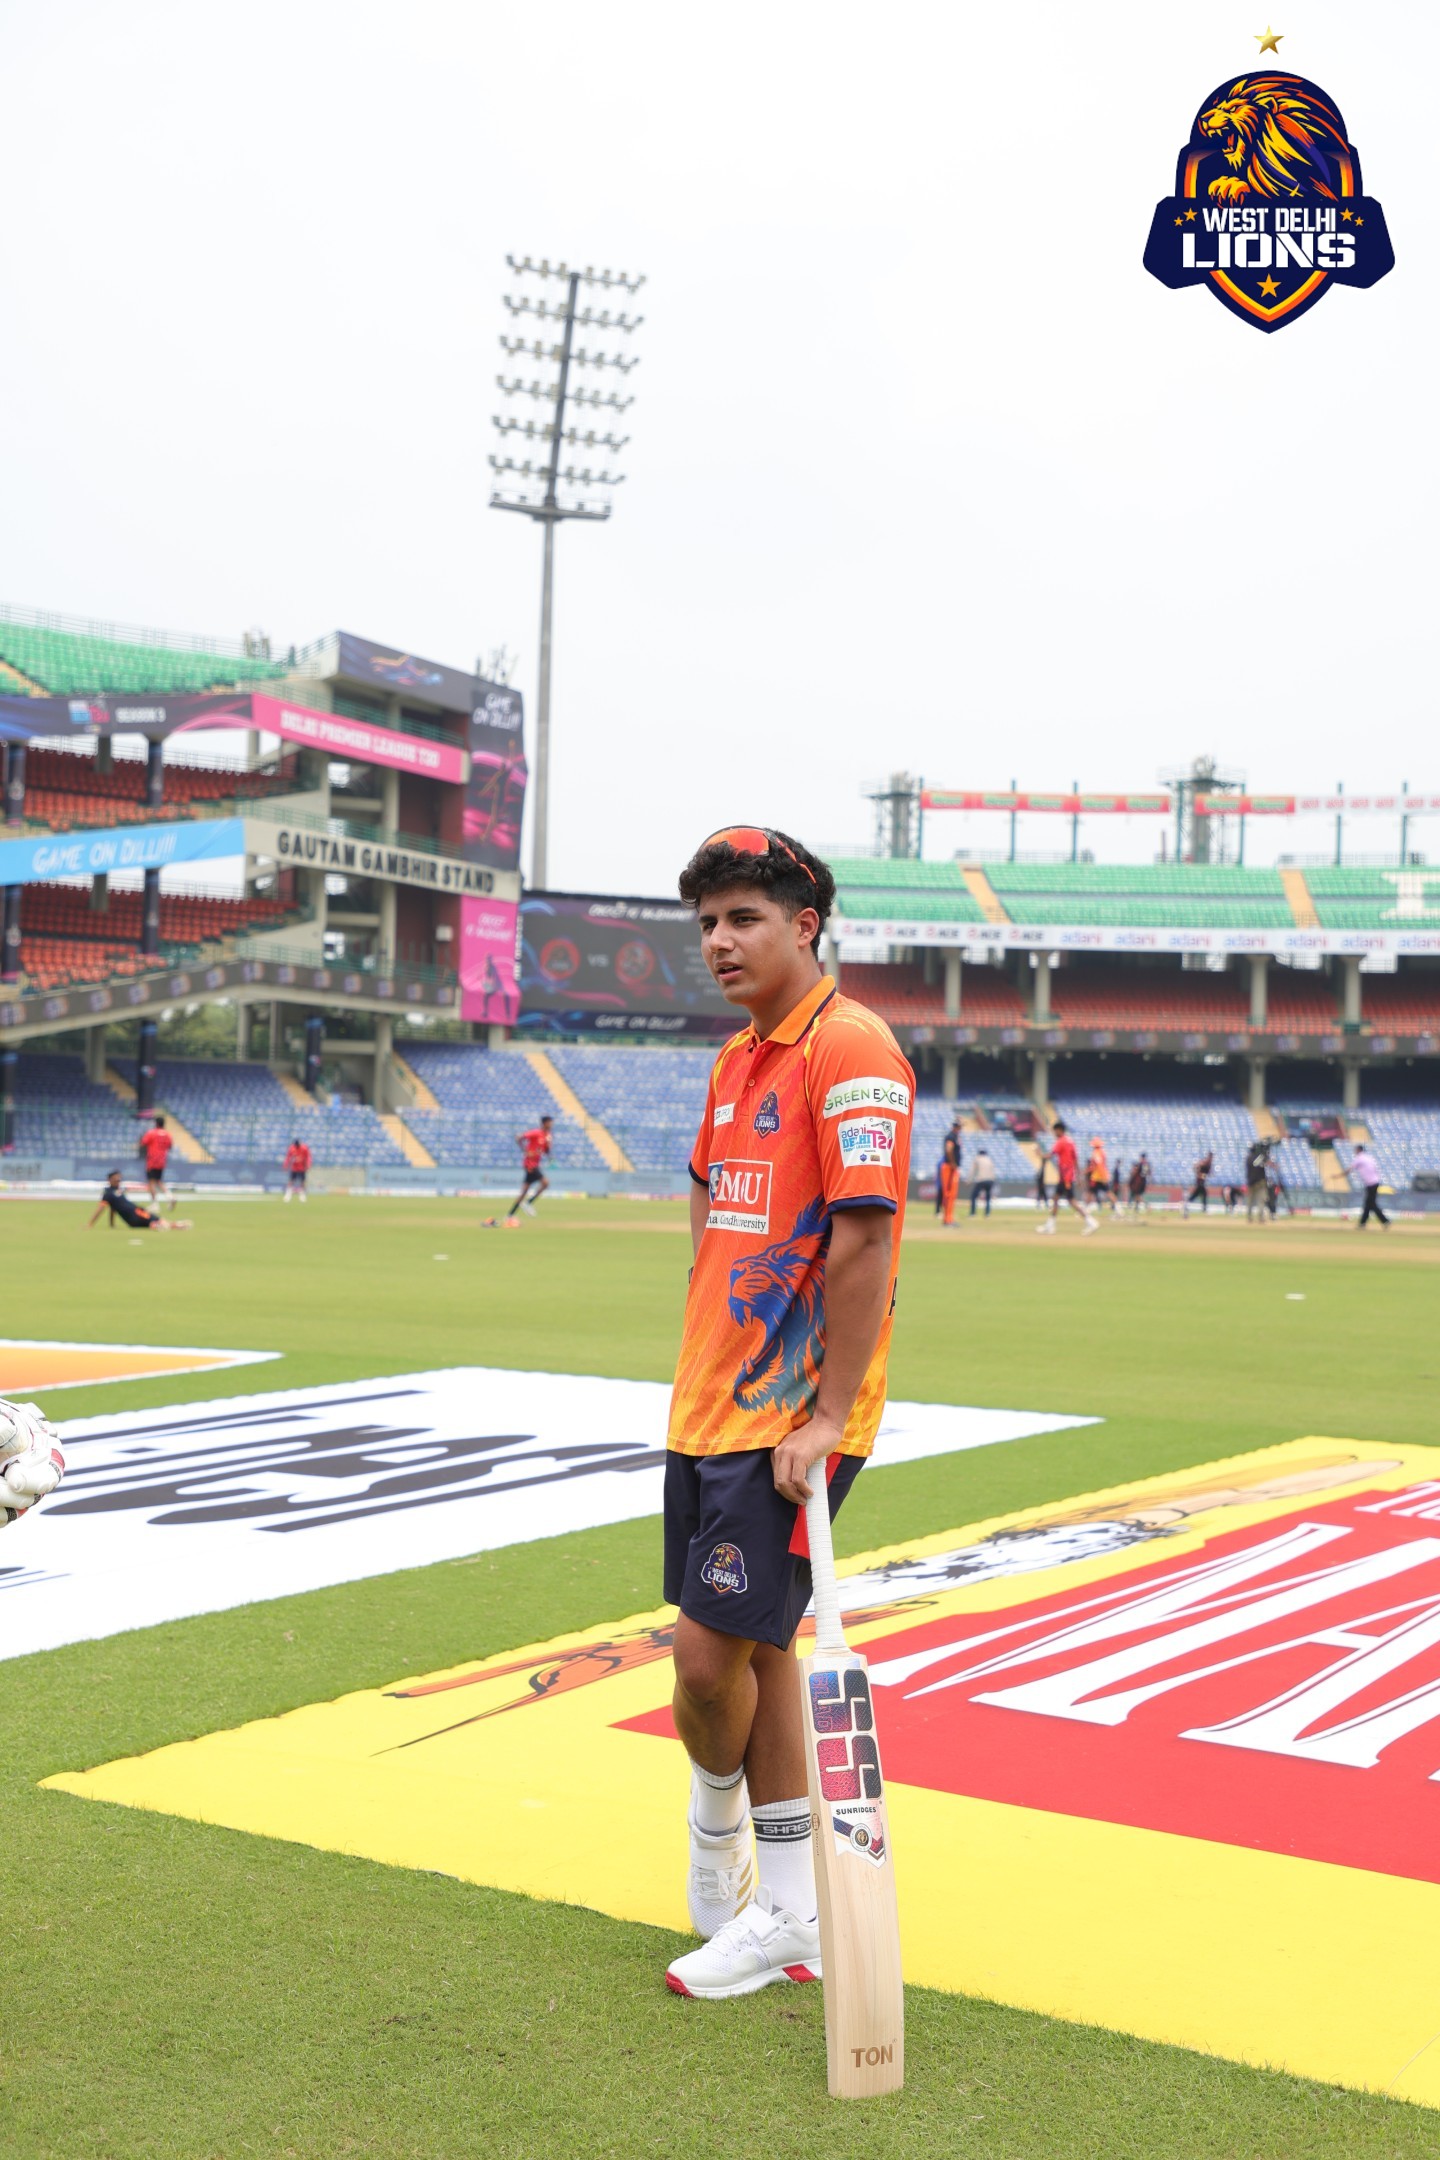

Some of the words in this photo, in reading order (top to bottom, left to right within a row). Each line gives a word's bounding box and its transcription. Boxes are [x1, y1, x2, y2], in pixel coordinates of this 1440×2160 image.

[319, 720, 371, 751] PREMIER
[372, 734, 417, 763] LEAGUE
[32, 843, 84, 874] GAME
[89, 840, 114, 866] ON
[278, 831, 356, 867] GAUTAM
[361, 848, 438, 883] GAMBHIR
[442, 864, 495, 893] STAND
[755, 1120, 776, 1129] LIONS
[841, 1124, 867, 1138] adani
[707, 1570, 740, 1588] LIONS
[835, 1806, 877, 1815] SUNRIDGES
[762, 1822, 811, 1835] SHREY
[850, 2043, 893, 2068] TON
